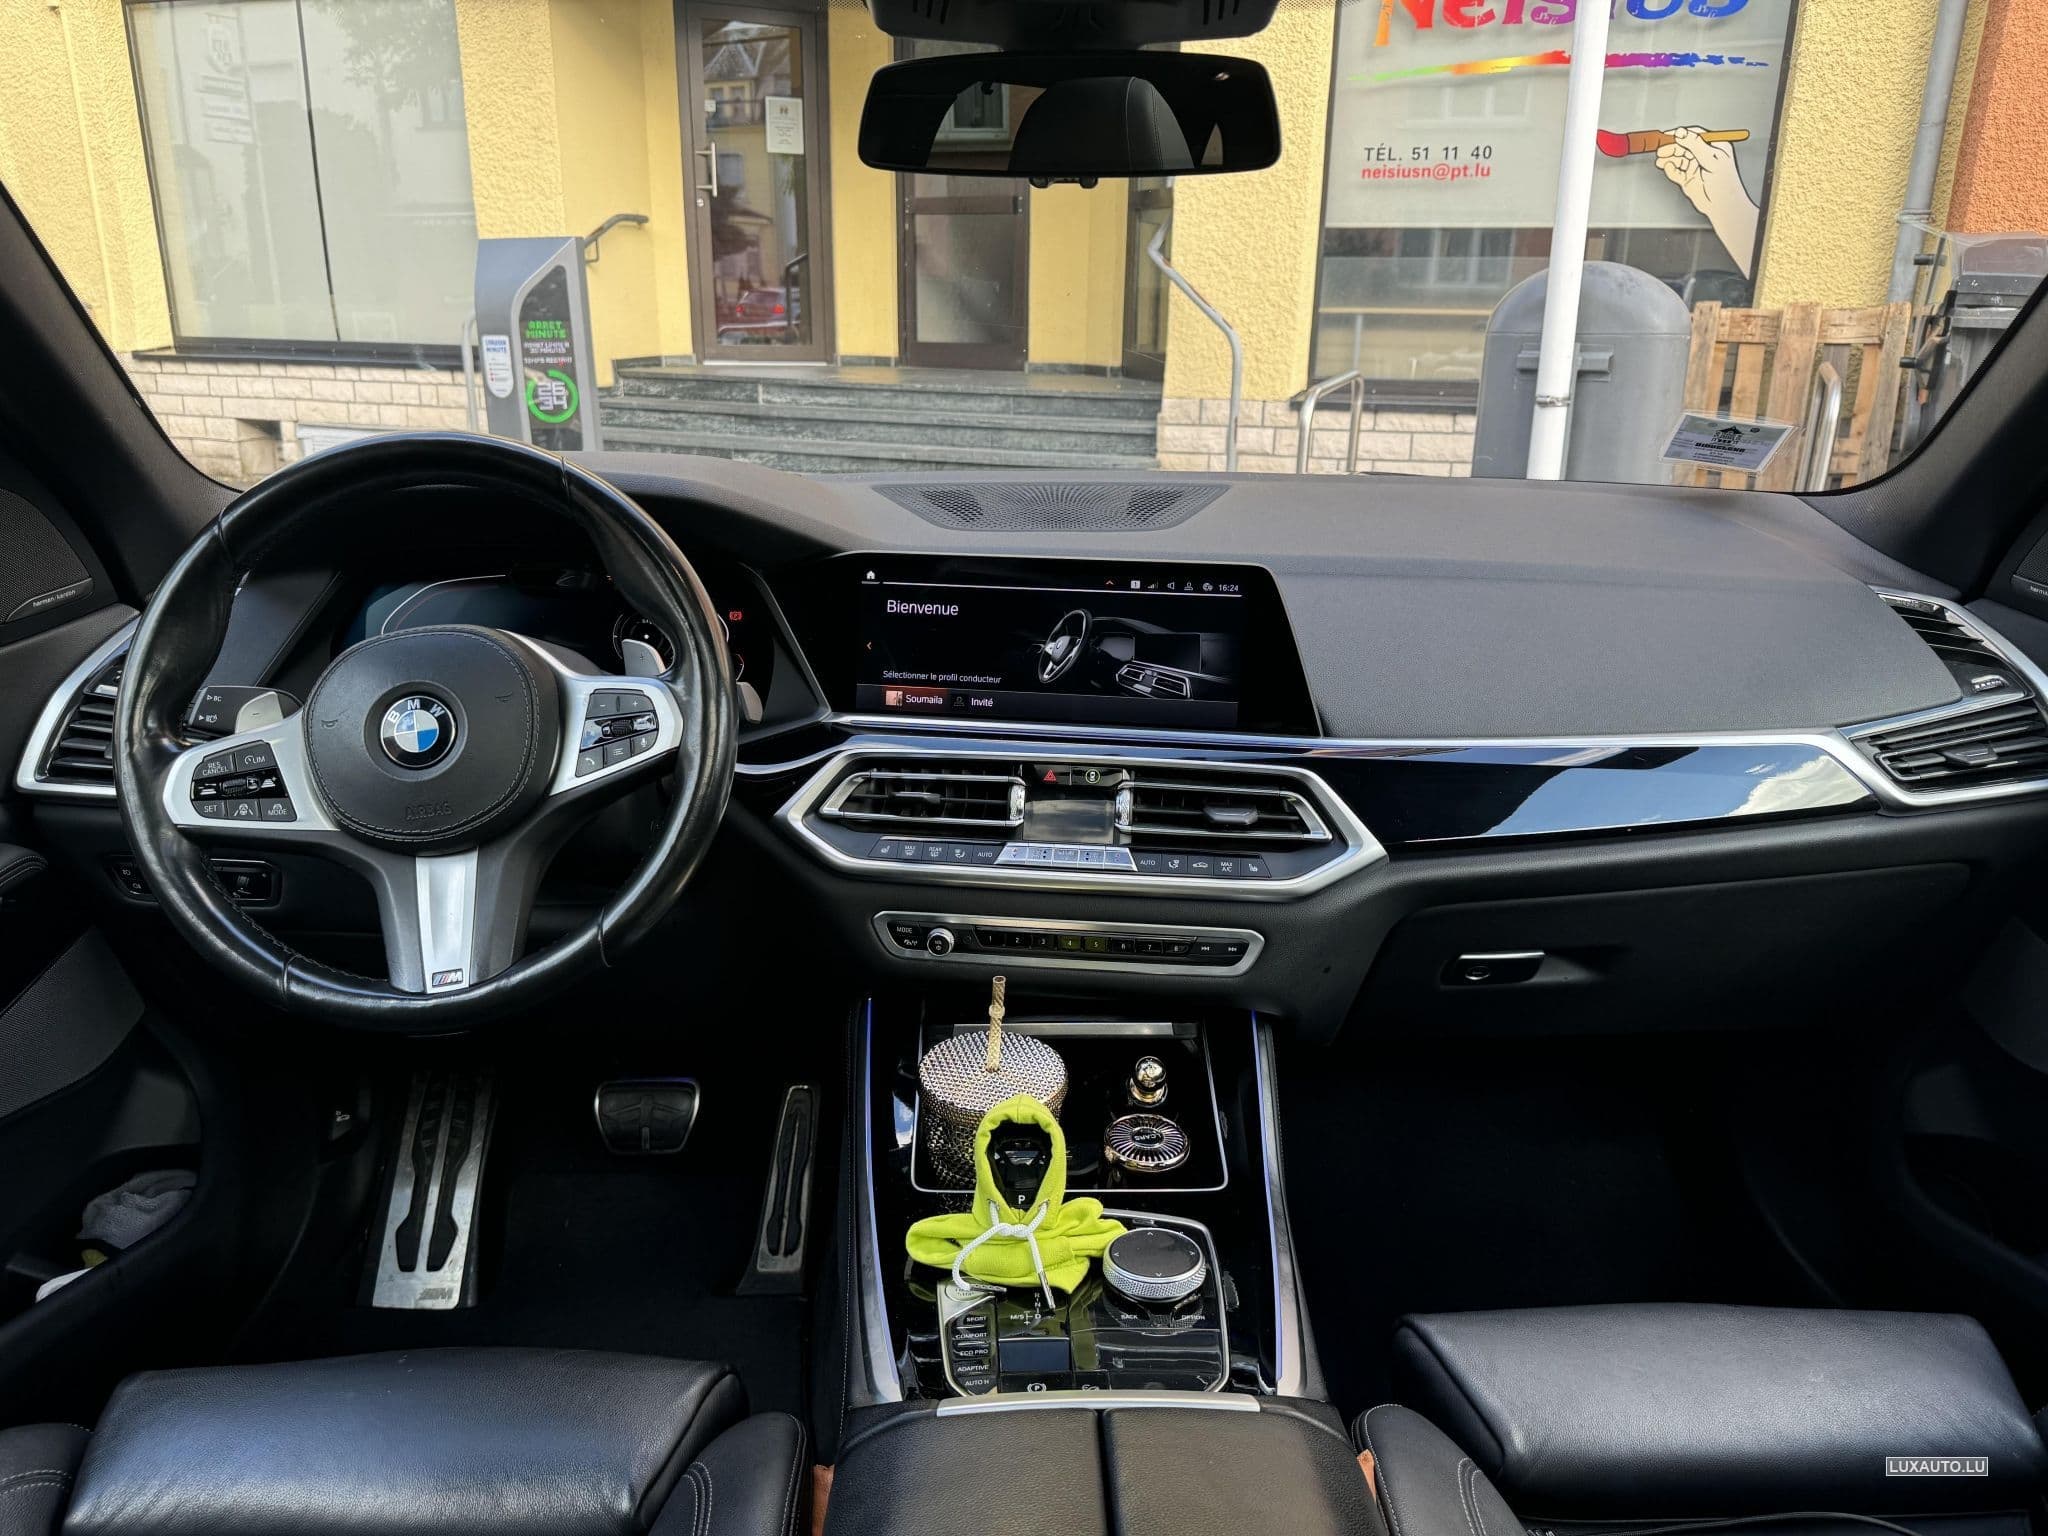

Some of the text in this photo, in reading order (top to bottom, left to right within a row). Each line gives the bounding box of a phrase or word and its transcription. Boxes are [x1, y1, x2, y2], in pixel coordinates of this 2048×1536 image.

[1364, 143, 1492, 161] TÉL. 51 11 40
[1361, 163, 1491, 181] neisiusn@pt.lu
[1218, 584, 1239, 592] 16:24
[886, 599, 959, 616] Bienvenue
[882, 670, 929, 680] Sélectionner
[938, 673, 958, 683] profil
[959, 675, 1002, 684] conducteur
[971, 697, 994, 707] Invité
[387, 698, 446, 724] BMW
[202, 767, 229, 776] CANCEL
[204, 805, 218, 813] SET
[896, 926, 913, 934] MODE
[1018, 1195, 1026, 1204] P
[957, 1364, 989, 1372] ADAPTIVE
